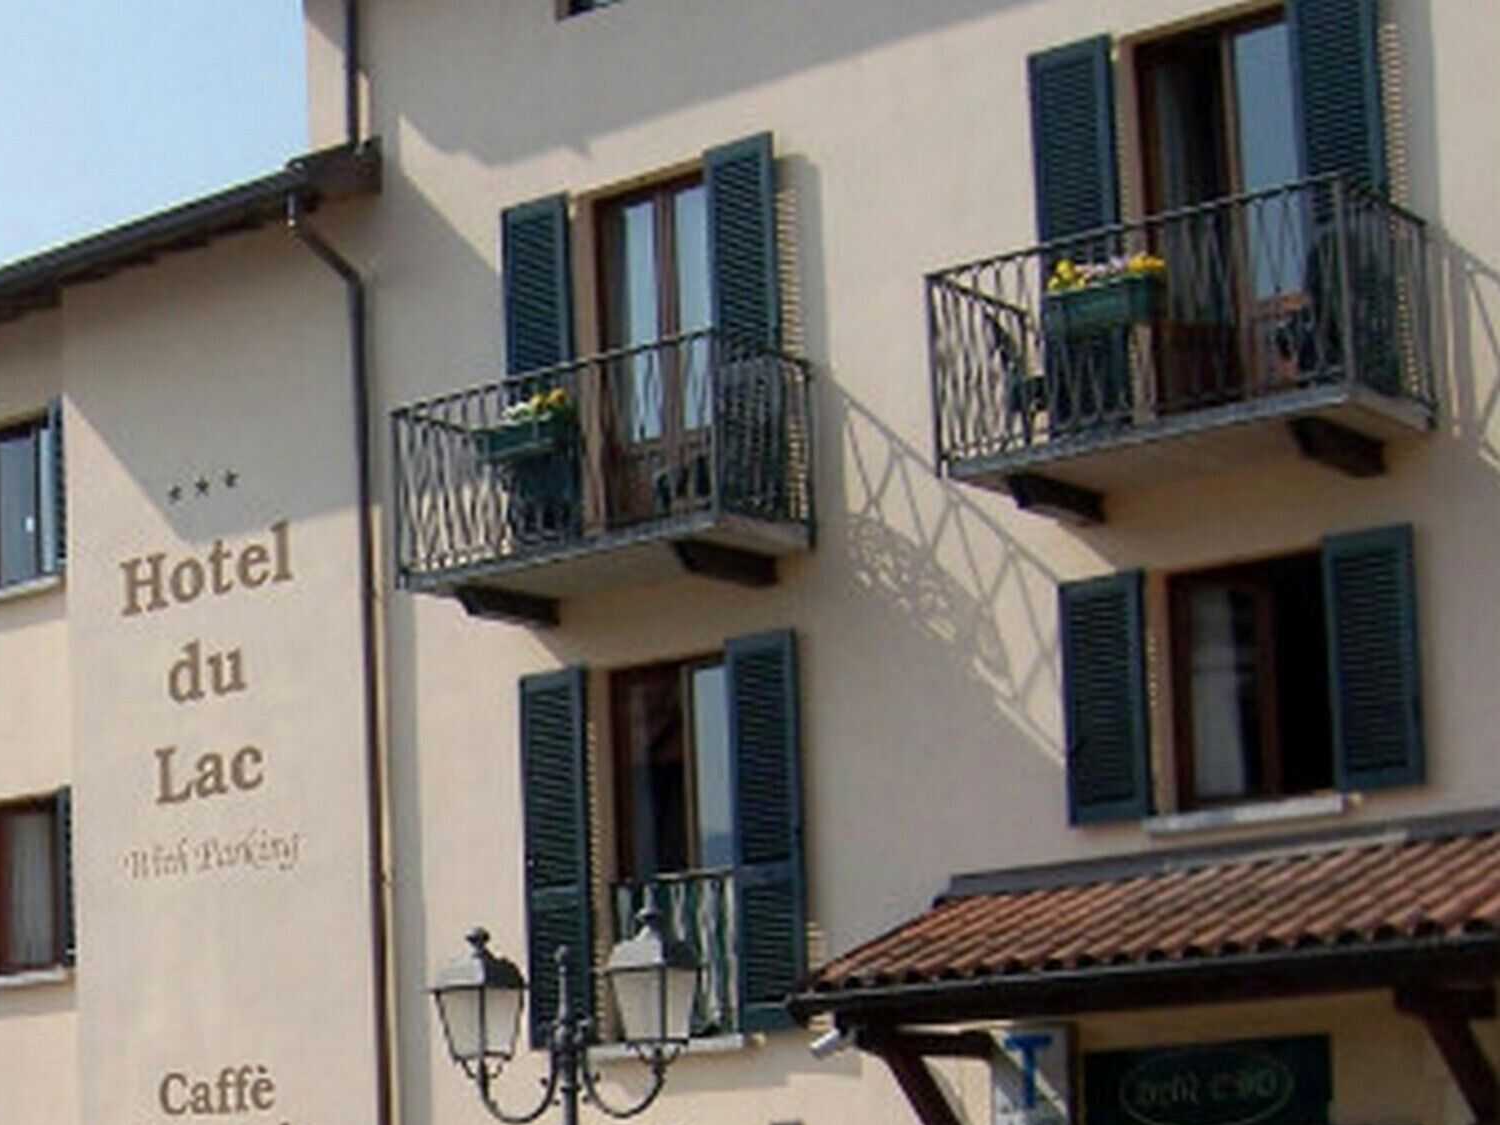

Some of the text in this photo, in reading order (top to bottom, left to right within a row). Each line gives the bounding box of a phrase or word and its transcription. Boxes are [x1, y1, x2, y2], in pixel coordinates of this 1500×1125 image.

[119, 521, 295, 617] Hotel
[167, 639, 247, 704] du
[153, 743, 266, 806] Lac
[158, 1064, 276, 1115] Caffè
[1004, 1034, 1054, 1108] T
